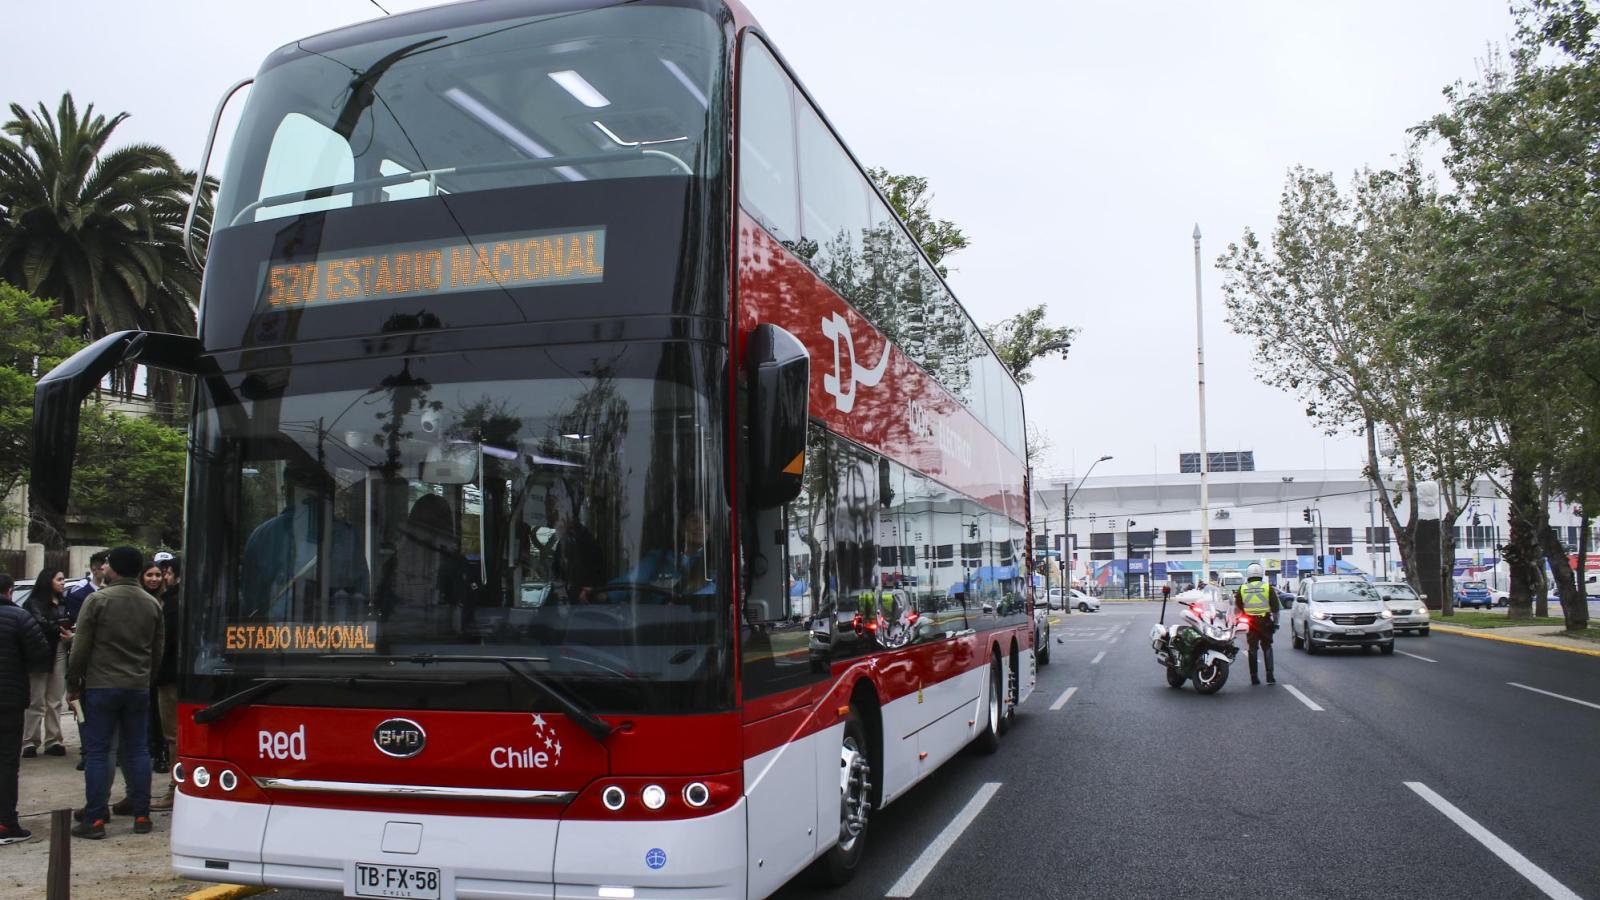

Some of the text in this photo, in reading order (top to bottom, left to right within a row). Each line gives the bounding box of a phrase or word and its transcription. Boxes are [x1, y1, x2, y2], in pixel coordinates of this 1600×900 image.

[269, 231, 604, 305] 520 ESTADIO NACIONAL
[226, 625, 375, 649] ESTADIO NACIONAL
[258, 724, 306, 760] Red
[379, 729, 419, 745] BYD
[490, 746, 549, 768] Chile
